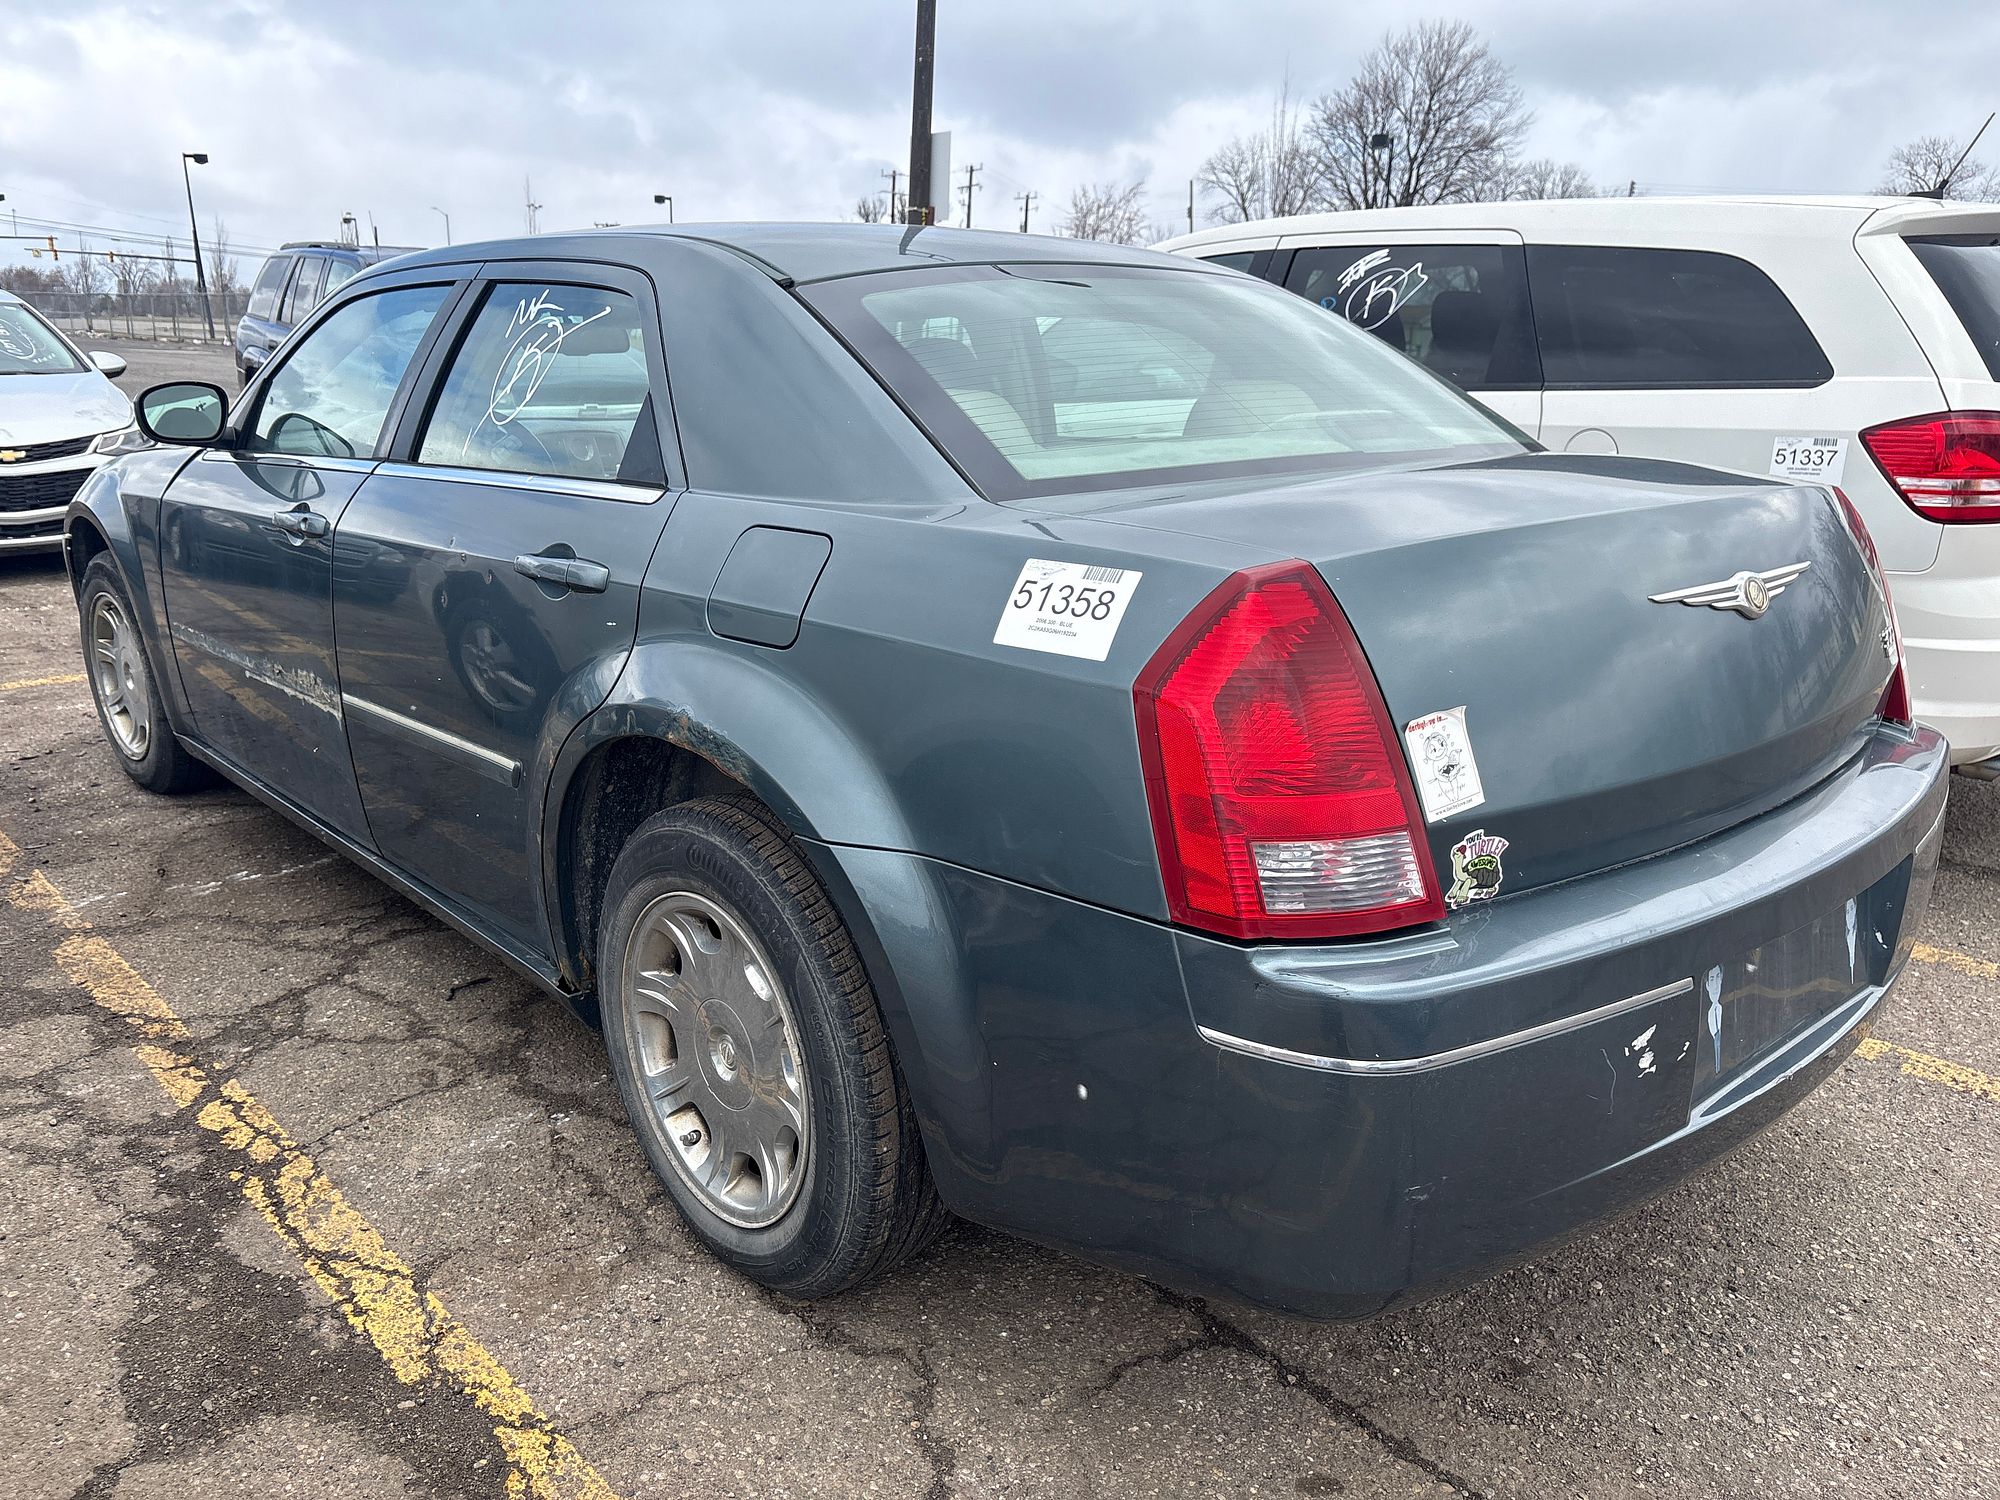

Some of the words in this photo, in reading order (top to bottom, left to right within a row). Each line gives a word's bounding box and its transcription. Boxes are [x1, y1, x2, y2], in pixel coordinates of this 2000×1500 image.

[1774, 447, 1839, 467] 51337
[1013, 579, 1116, 621] 51358
[1408, 717, 1436, 733] derbylve
[1466, 831, 1483, 845] YOU'RE
[1469, 838, 1508, 859] TURTLEY
[1470, 857, 1496, 869] AWESOME
